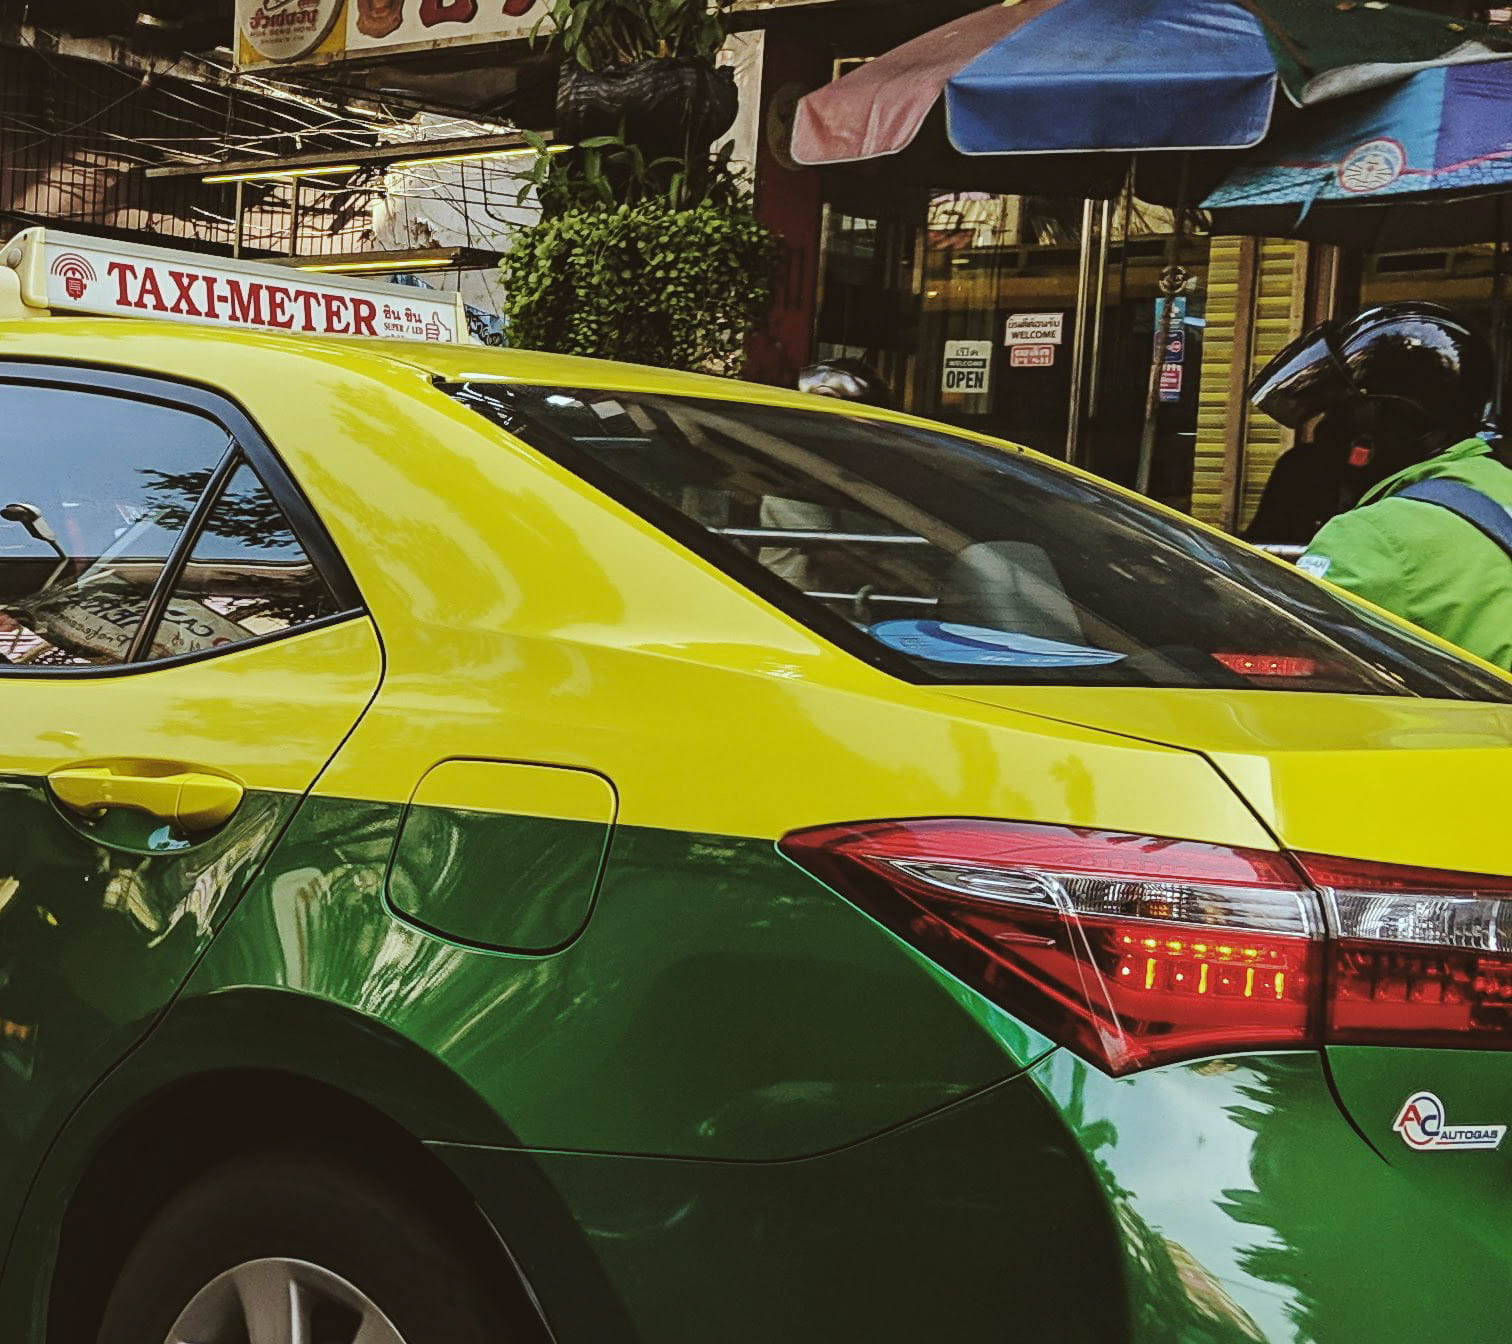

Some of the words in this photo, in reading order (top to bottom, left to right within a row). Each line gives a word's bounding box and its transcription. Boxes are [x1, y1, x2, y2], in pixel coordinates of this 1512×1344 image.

[106, 261, 379, 337] TAXI-METER
[1011, 330, 1057, 340] WELCOME
[946, 370, 984, 389] OPEN
